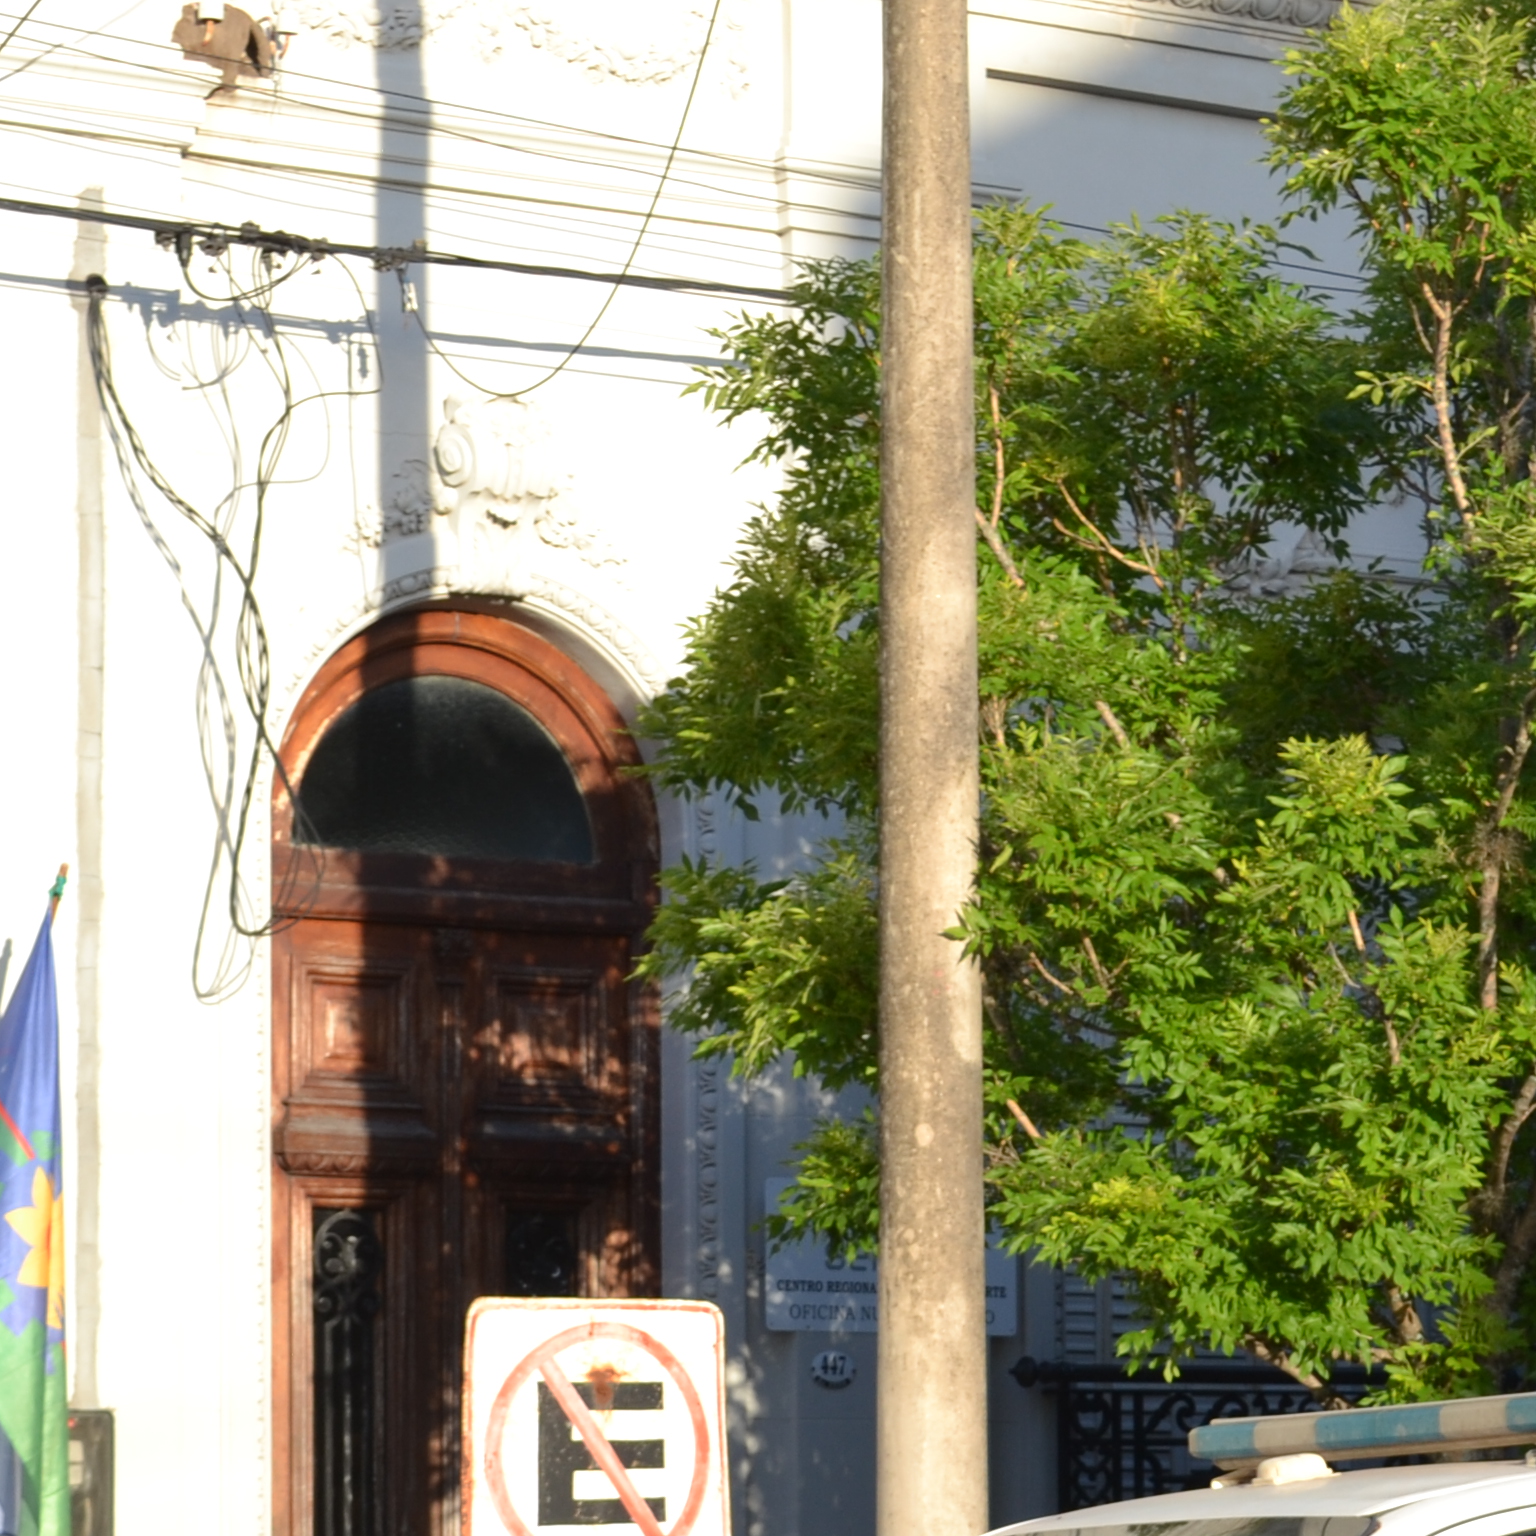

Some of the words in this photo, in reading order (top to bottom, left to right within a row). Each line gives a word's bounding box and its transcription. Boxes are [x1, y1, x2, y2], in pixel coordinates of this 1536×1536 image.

[777, 1279, 823, 1293] CENTRO
[827, 1280, 877, 1294] REGIONA
[789, 1304, 855, 1322] OFICINA
[821, 1355, 847, 1375] 447
